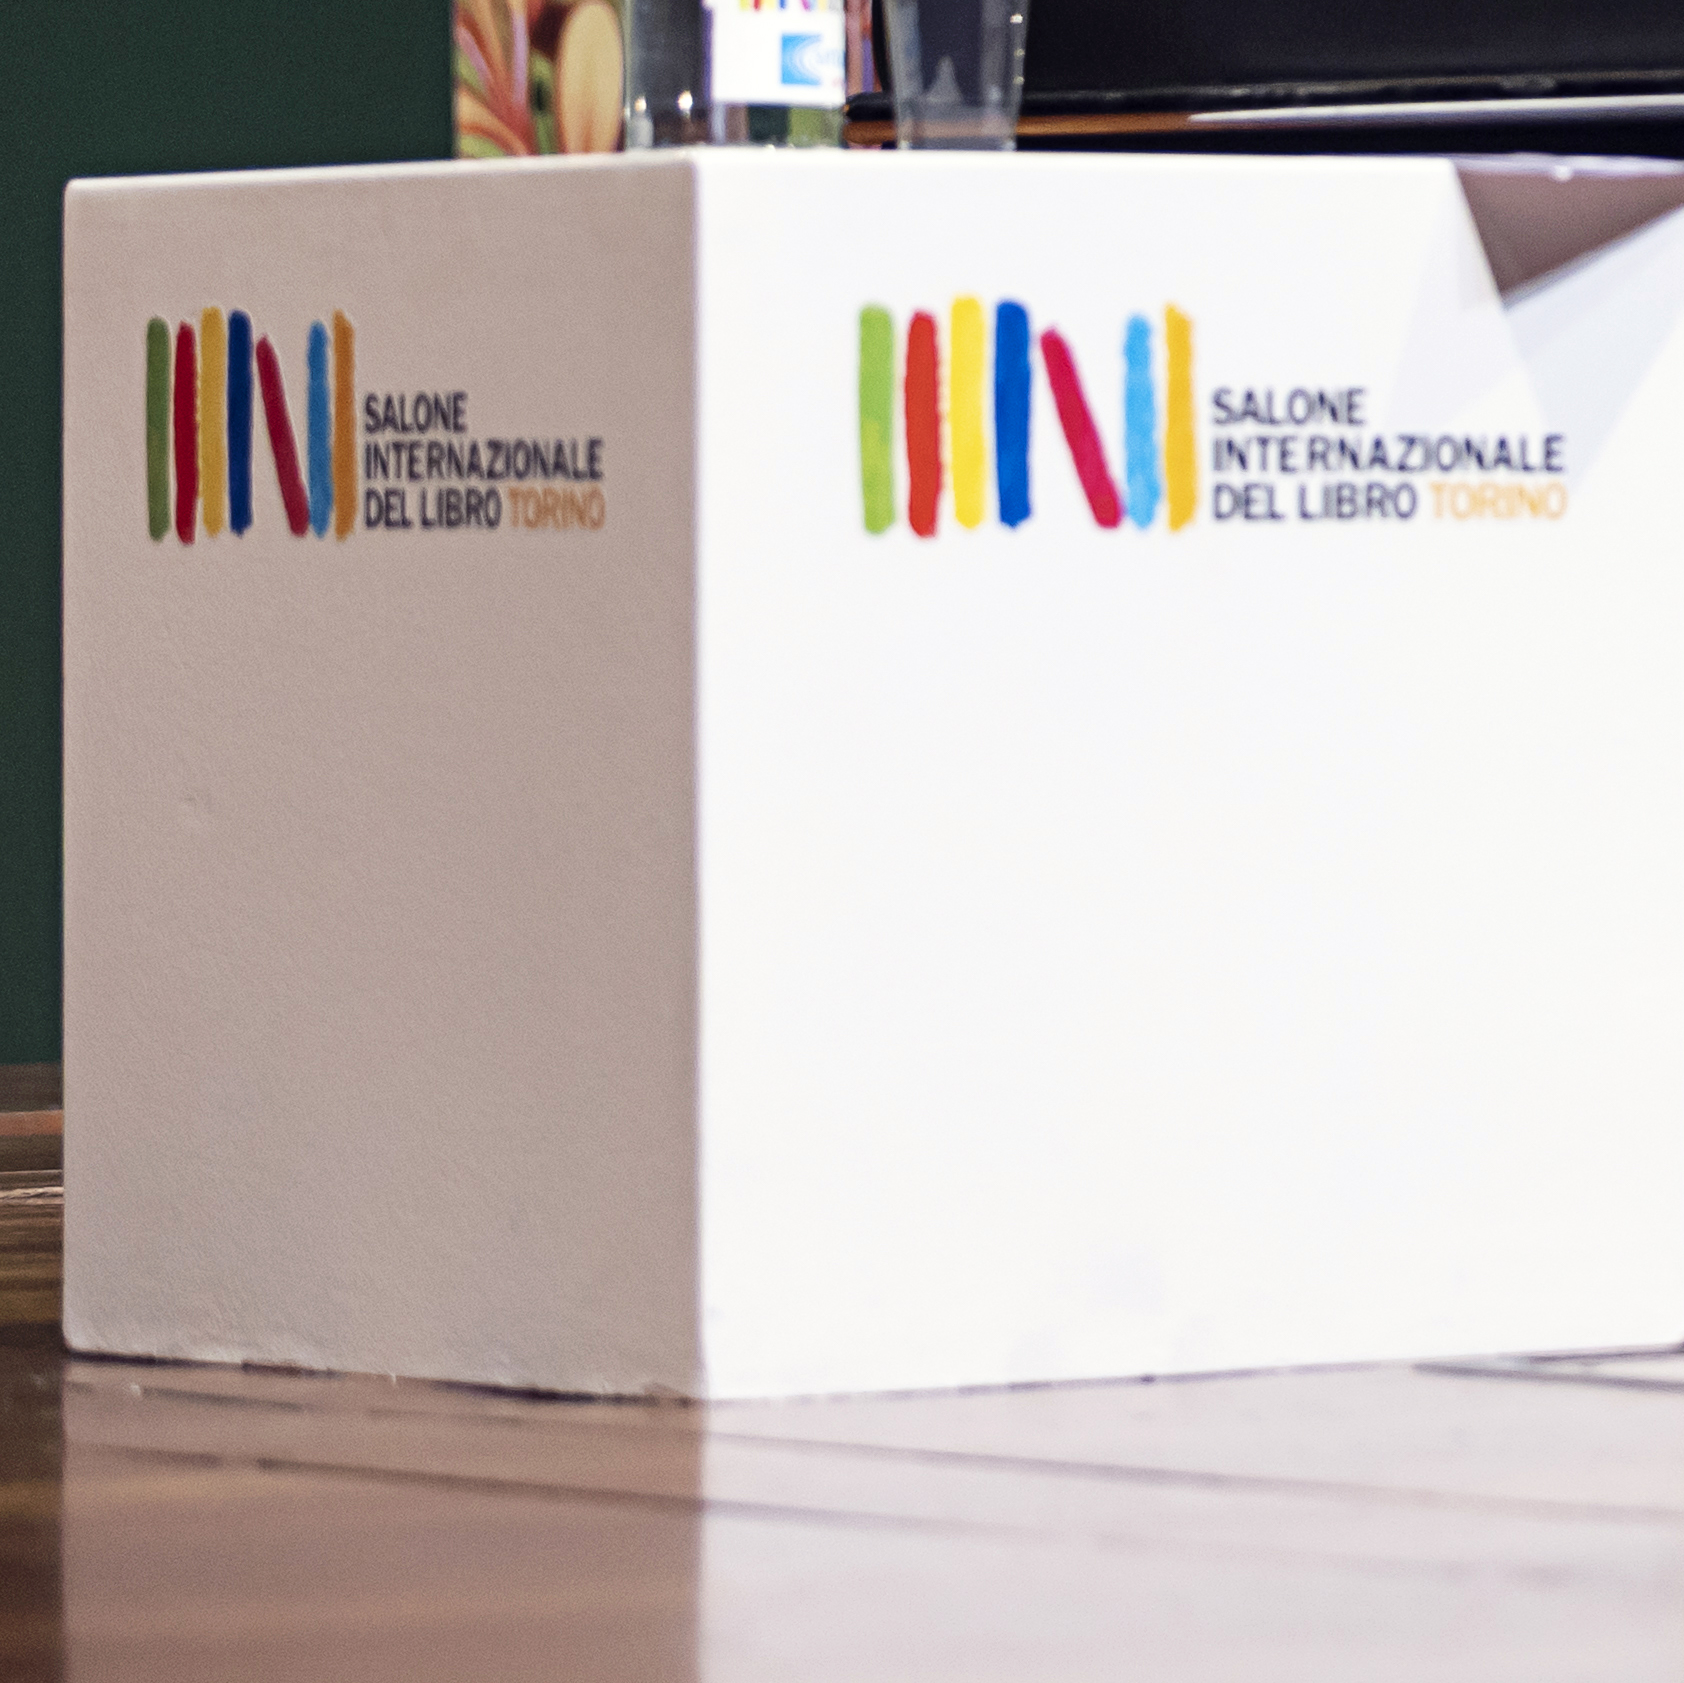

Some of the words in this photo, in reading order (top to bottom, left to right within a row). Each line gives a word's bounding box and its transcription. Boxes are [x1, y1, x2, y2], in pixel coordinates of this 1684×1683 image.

[363, 391, 468, 433] SALONE
[1211, 387, 1365, 427] SALONE
[363, 437, 604, 482] INTERNAZIONALE
[1211, 434, 1564, 473] INTERNAZIONALE
[363, 486, 413, 531] DEL
[419, 486, 503, 531] LIBRO
[507, 486, 606, 531] TORINO
[1211, 482, 1285, 522] DEL
[1297, 481, 1418, 522] LIBRO
[1428, 481, 1568, 522] TORINO
